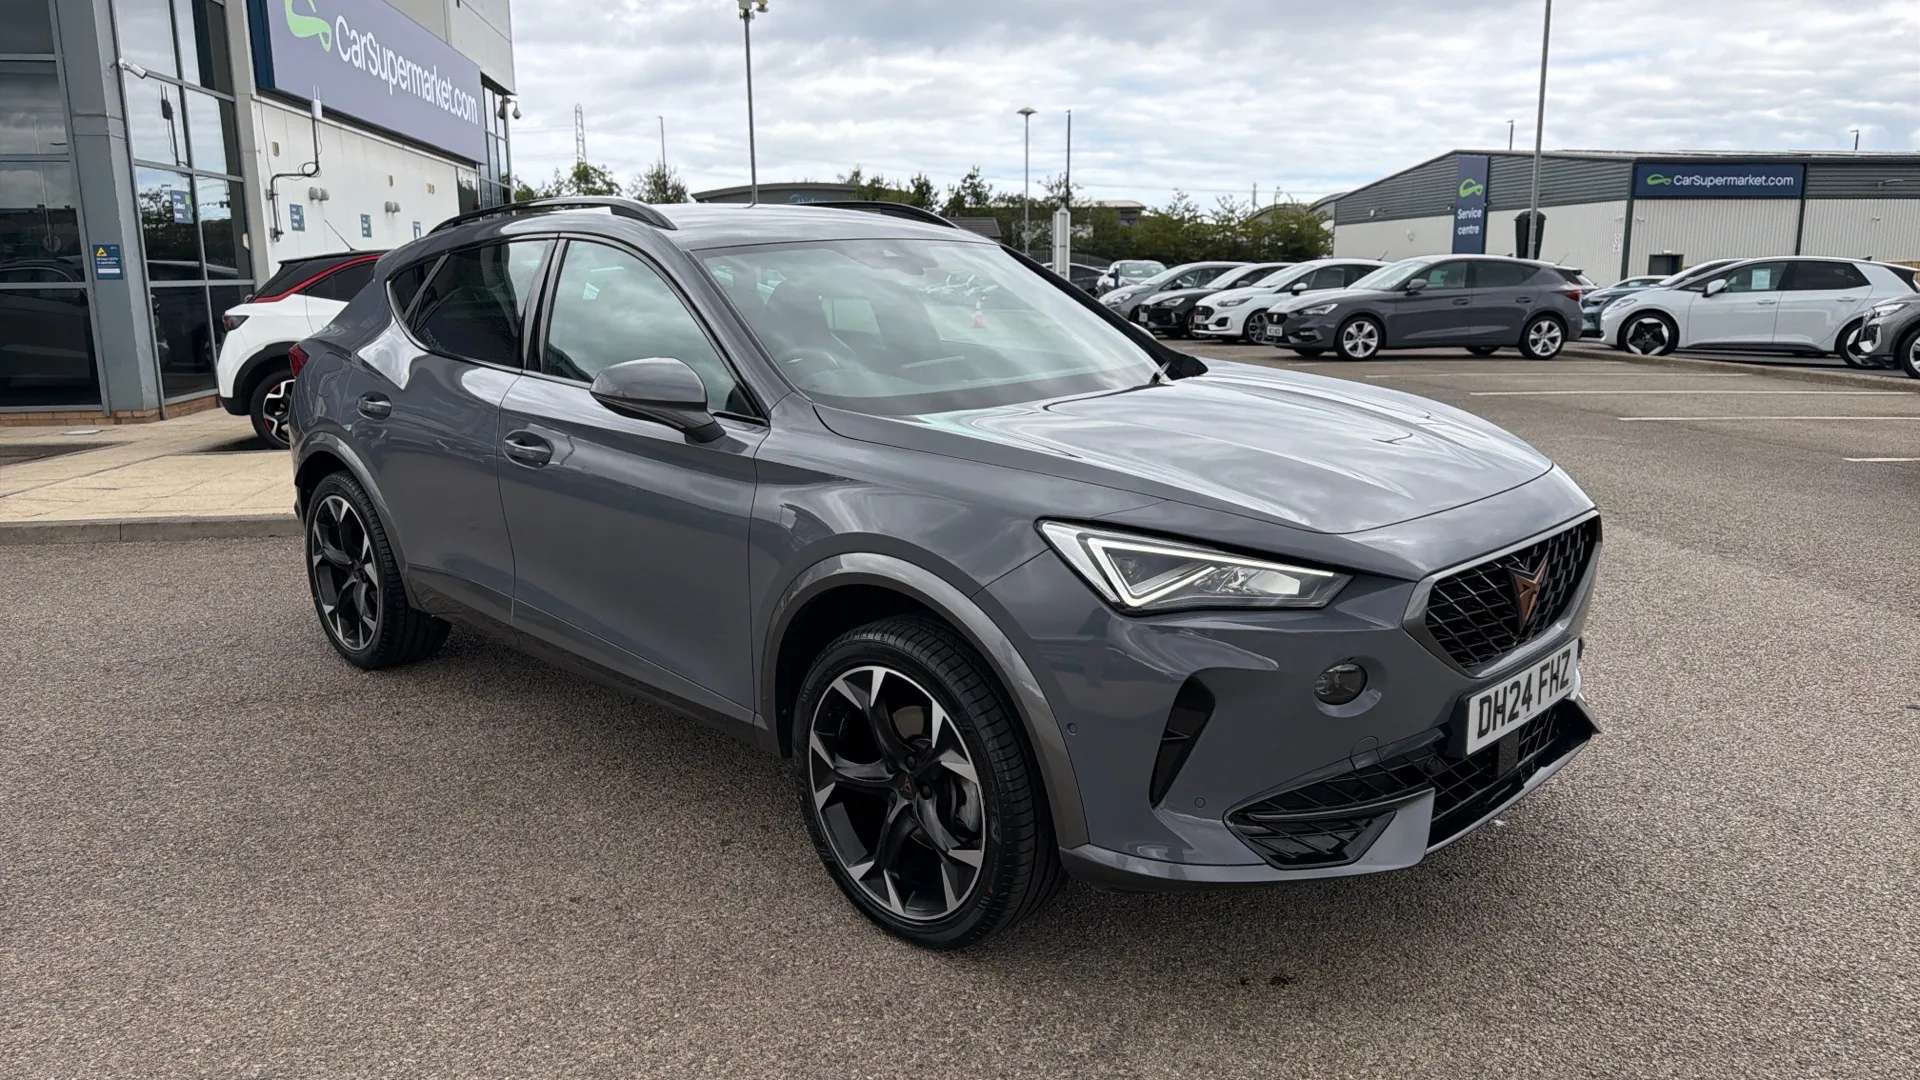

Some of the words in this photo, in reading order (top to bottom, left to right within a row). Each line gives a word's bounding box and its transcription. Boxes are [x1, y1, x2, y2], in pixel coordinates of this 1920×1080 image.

[335, 15, 479, 126] CarSupermarket.com
[1673, 174, 1794, 188] CarSupermarket.com
[1457, 207, 1482, 220] Service
[1457, 225, 1480, 235] centre
[1477, 673, 1533, 740] DH24
[1538, 648, 1571, 705] FHZ
